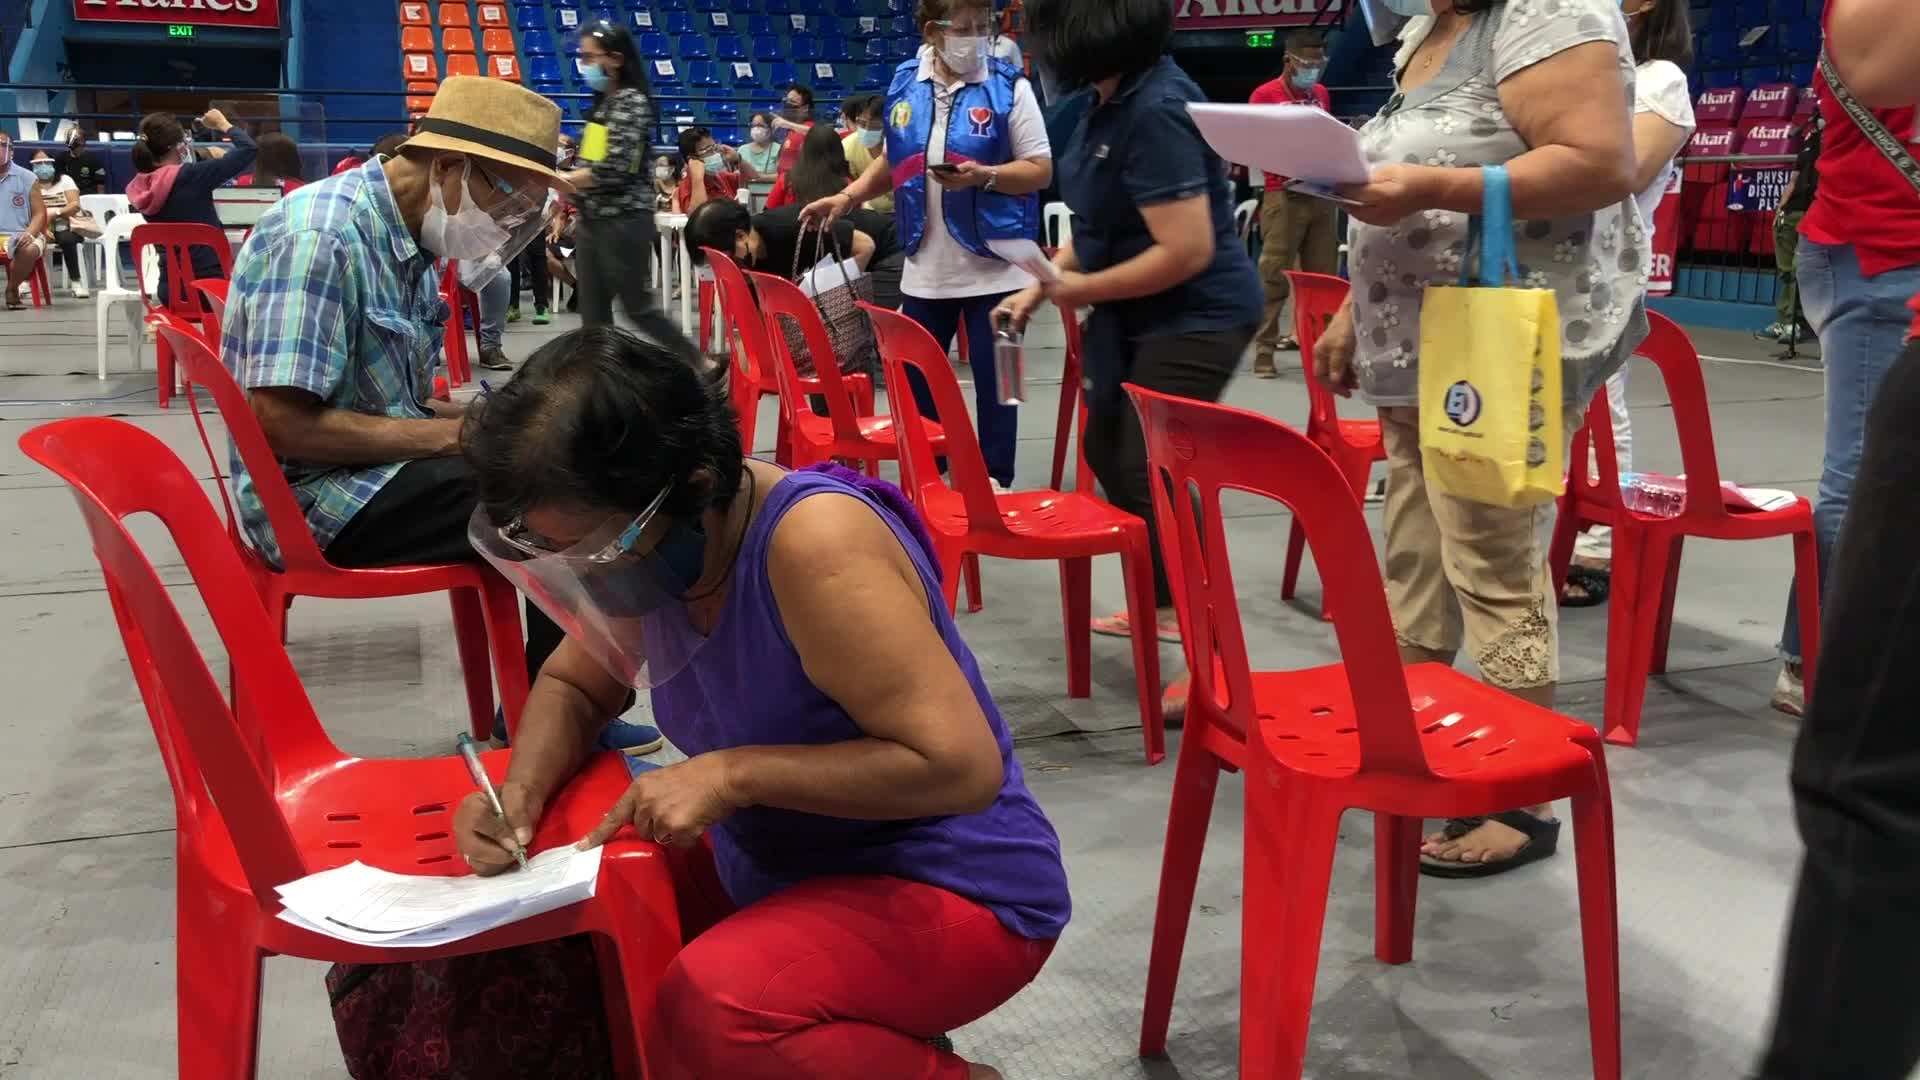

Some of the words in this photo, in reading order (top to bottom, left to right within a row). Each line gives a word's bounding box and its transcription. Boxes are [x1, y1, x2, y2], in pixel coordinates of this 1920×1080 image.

[169, 25, 193, 36] EXIT
[1697, 90, 1736, 105] Akari
[1747, 86, 1789, 102] Akari
[1690, 131, 1732, 145] Akari
[1747, 124, 1791, 139] Akari
